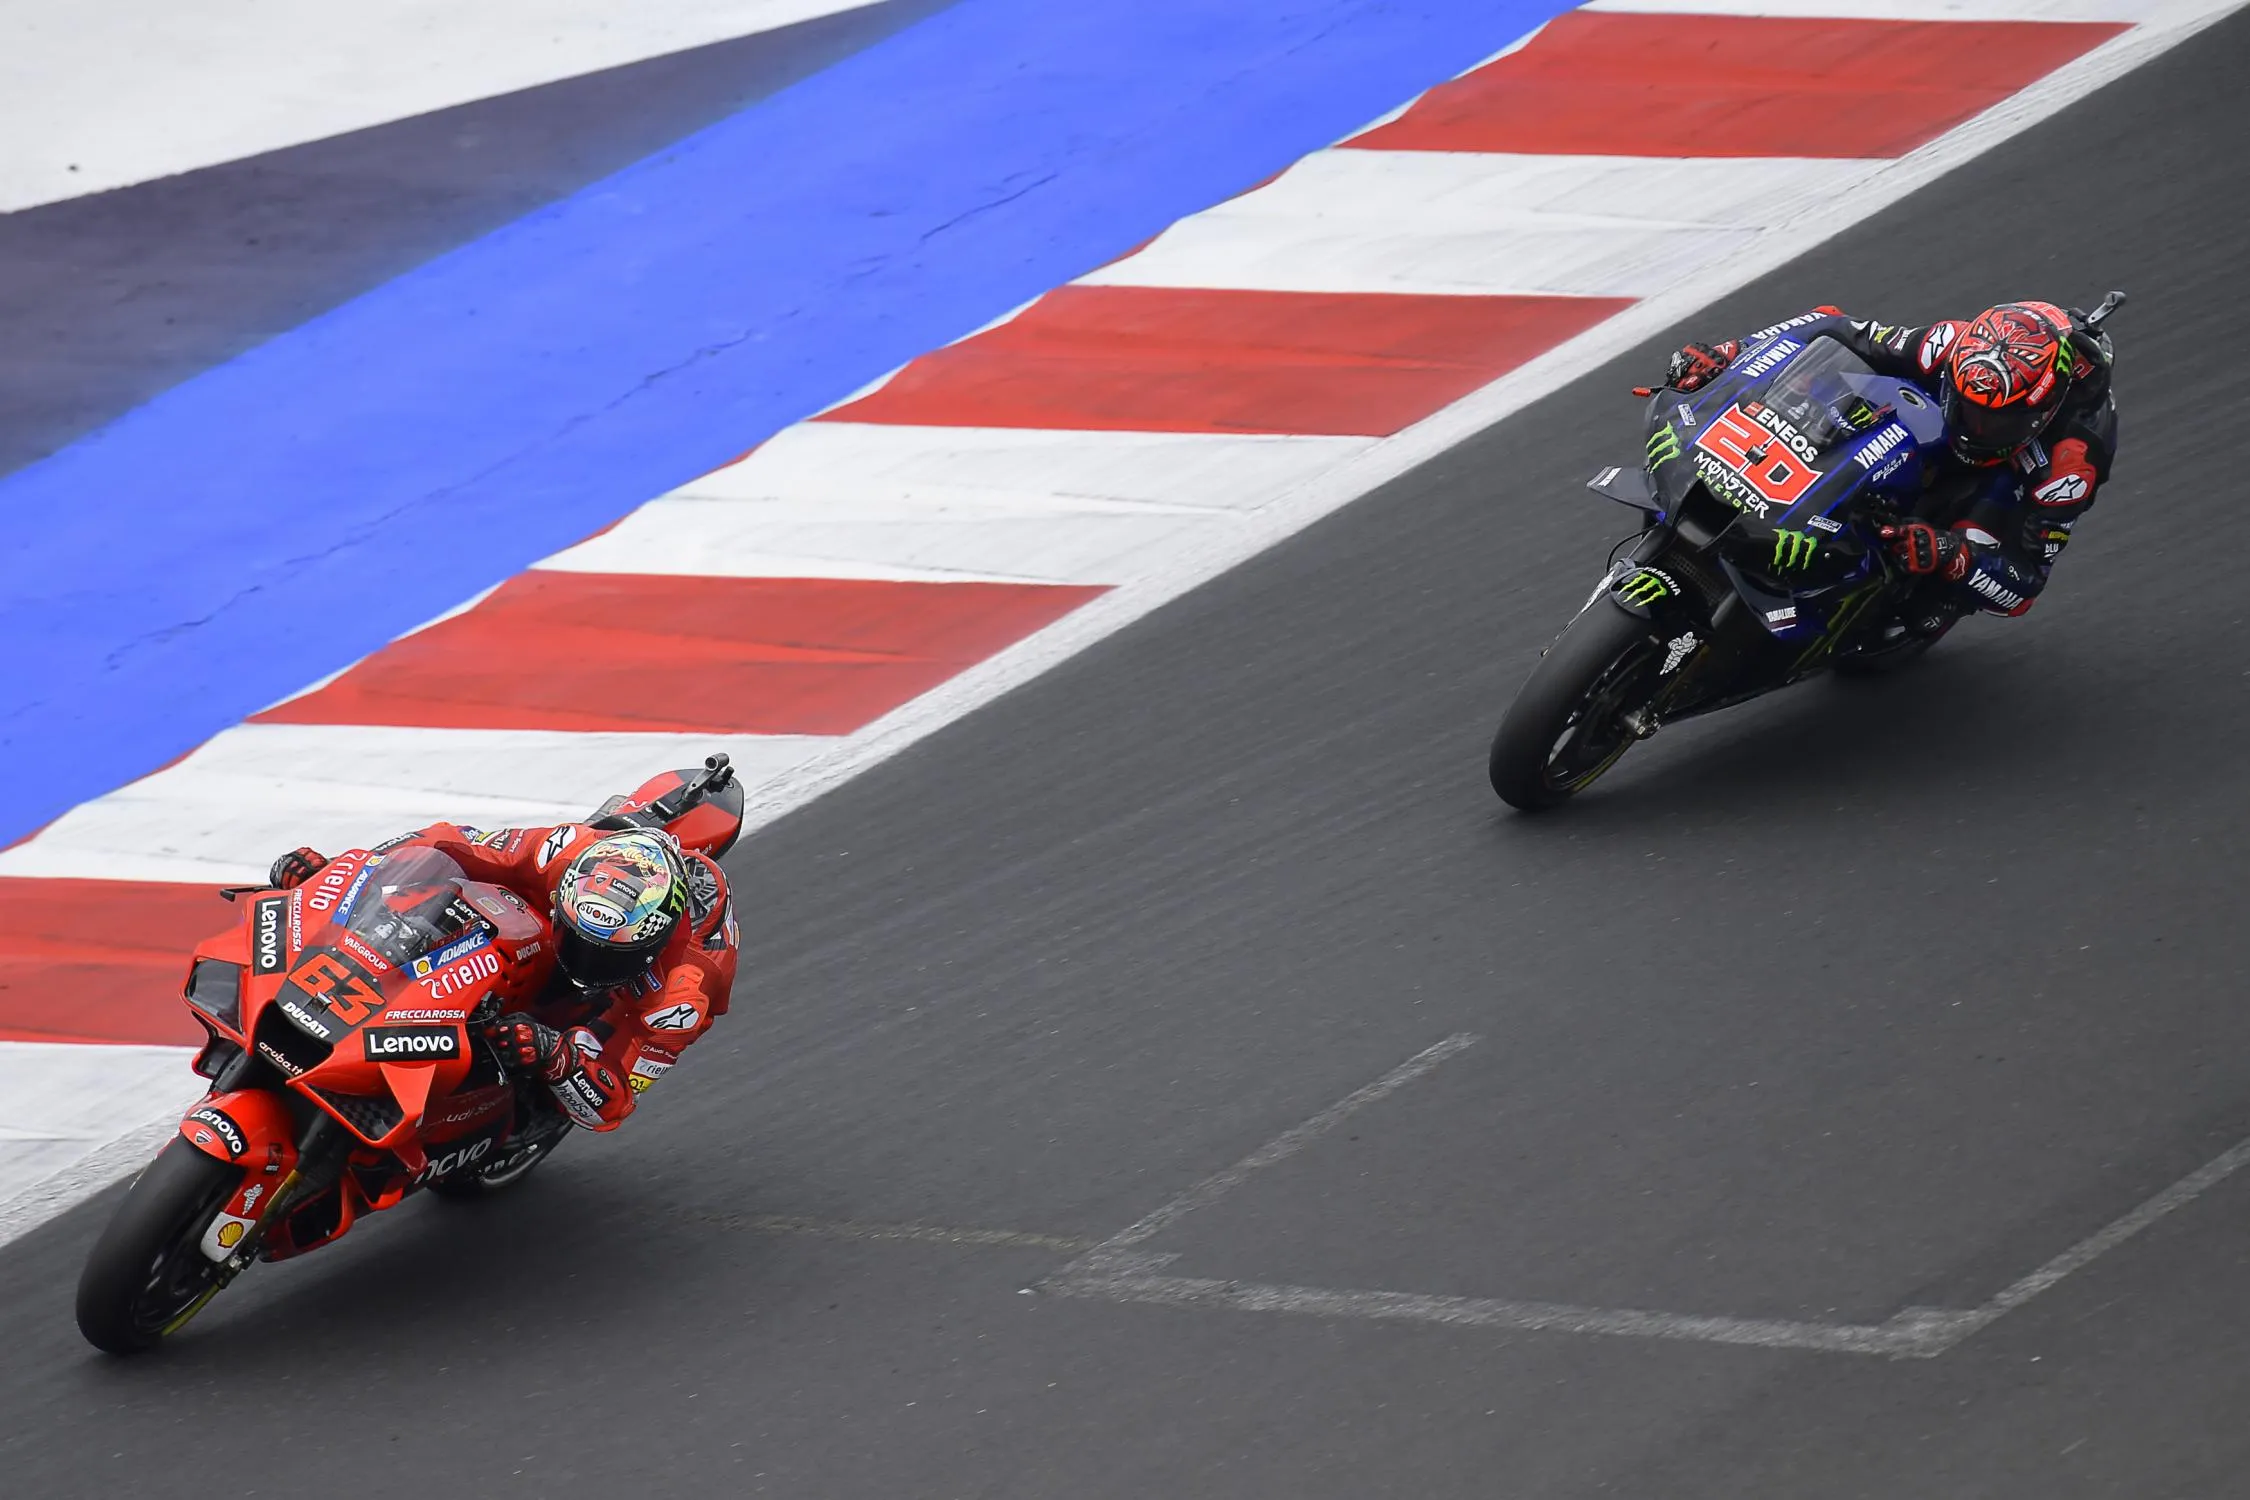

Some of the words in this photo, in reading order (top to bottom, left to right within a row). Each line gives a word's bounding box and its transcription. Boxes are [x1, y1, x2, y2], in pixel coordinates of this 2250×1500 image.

[1741, 338, 1802, 379] YAMAHA
[1757, 409, 1819, 463] ENEOS
[1853, 423, 1909, 470] YAMAHA
[1694, 451, 1770, 519] MONSTER
[1696, 469, 1751, 515] ENERGY
[1644, 565, 1682, 596] YAMAHA
[1967, 568, 2024, 610] YAMAHA
[308, 861, 354, 911] riello
[338, 869, 369, 915] ADVANCE
[612, 878, 638, 898] Lenovo
[260, 899, 282, 969] Lenovo
[292, 888, 303, 953] FRECCIAROSSA
[580, 903, 623, 928] SUOMY
[343, 935, 389, 972] VARGROUP
[437, 932, 485, 966] ADVANCE
[516, 941, 541, 961] DUCATI
[288, 953, 387, 1027] 63
[441, 953, 499, 995] riello
[282, 1001, 331, 1039] DUCATI
[384, 1009, 466, 1020] FRECCIAROSSA
[258, 1041, 303, 1076] aruba.it
[369, 1032, 454, 1054] Lenovo
[572, 1069, 604, 1107] Lenovo
[190, 1108, 242, 1153] Lenovo
